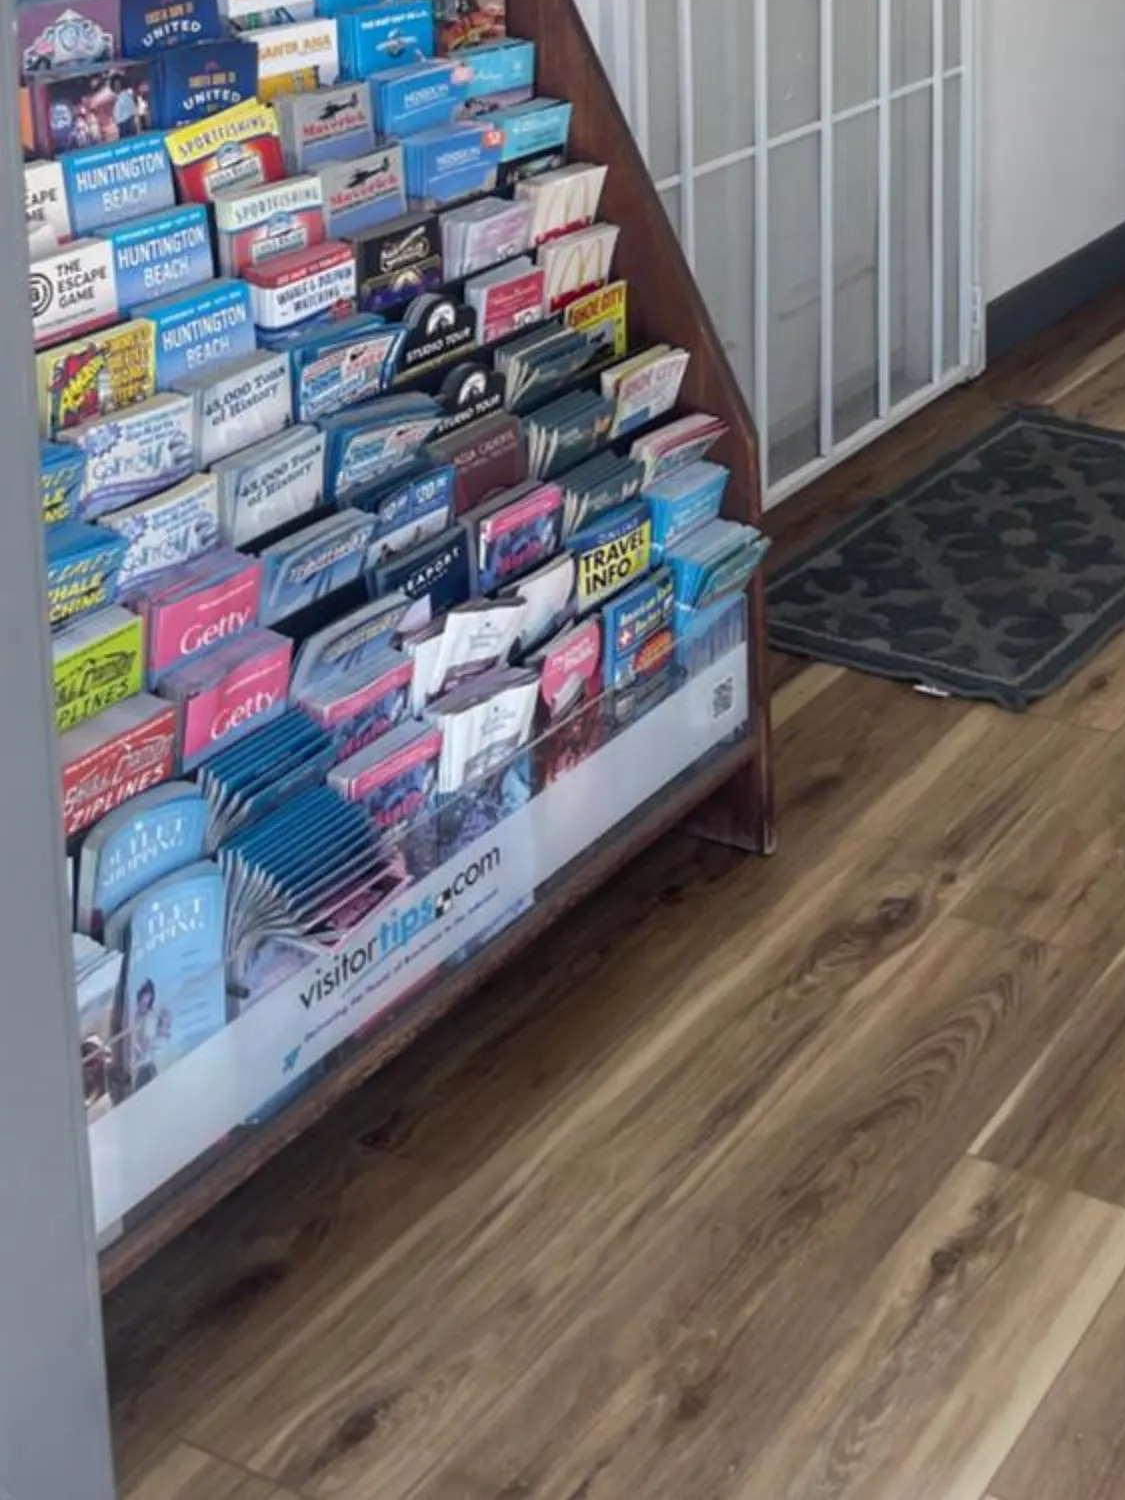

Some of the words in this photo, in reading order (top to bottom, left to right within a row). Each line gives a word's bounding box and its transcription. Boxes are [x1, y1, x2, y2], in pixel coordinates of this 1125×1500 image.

[142, 20, 202, 48] UNITED
[302, 33, 331, 51] ANA
[183, 88, 242, 110] UNITED
[179, 116, 266, 157] SPORTFISHING
[303, 111, 366, 137] Maverick
[76, 151, 165, 193] HUNTINGTON
[101, 182, 149, 212] BEACH
[235, 185, 319, 223] SPORTFISHING
[329, 176, 399, 206] Maverick
[118, 225, 205, 269] HUNTINGTON
[57, 258, 81, 276] THE
[58, 266, 107, 293] ESCAPE
[144, 257, 190, 288] BEACH
[58, 286, 95, 309] GAME
[161, 303, 247, 352] HUNTINGTON
[406, 338, 444, 363] STUDIO
[445, 327, 472, 345] TOUR
[186, 335, 231, 369] BEACH
[438, 406, 475, 432] STUDIO
[583, 529, 645, 573] TRAVEL
[585, 557, 632, 596] INFO
[179, 606, 252, 655] Getty
[57, 678, 130, 732] PLINES
[211, 687, 281, 740] Getty
[67, 765, 164, 836] ZIPLINES
